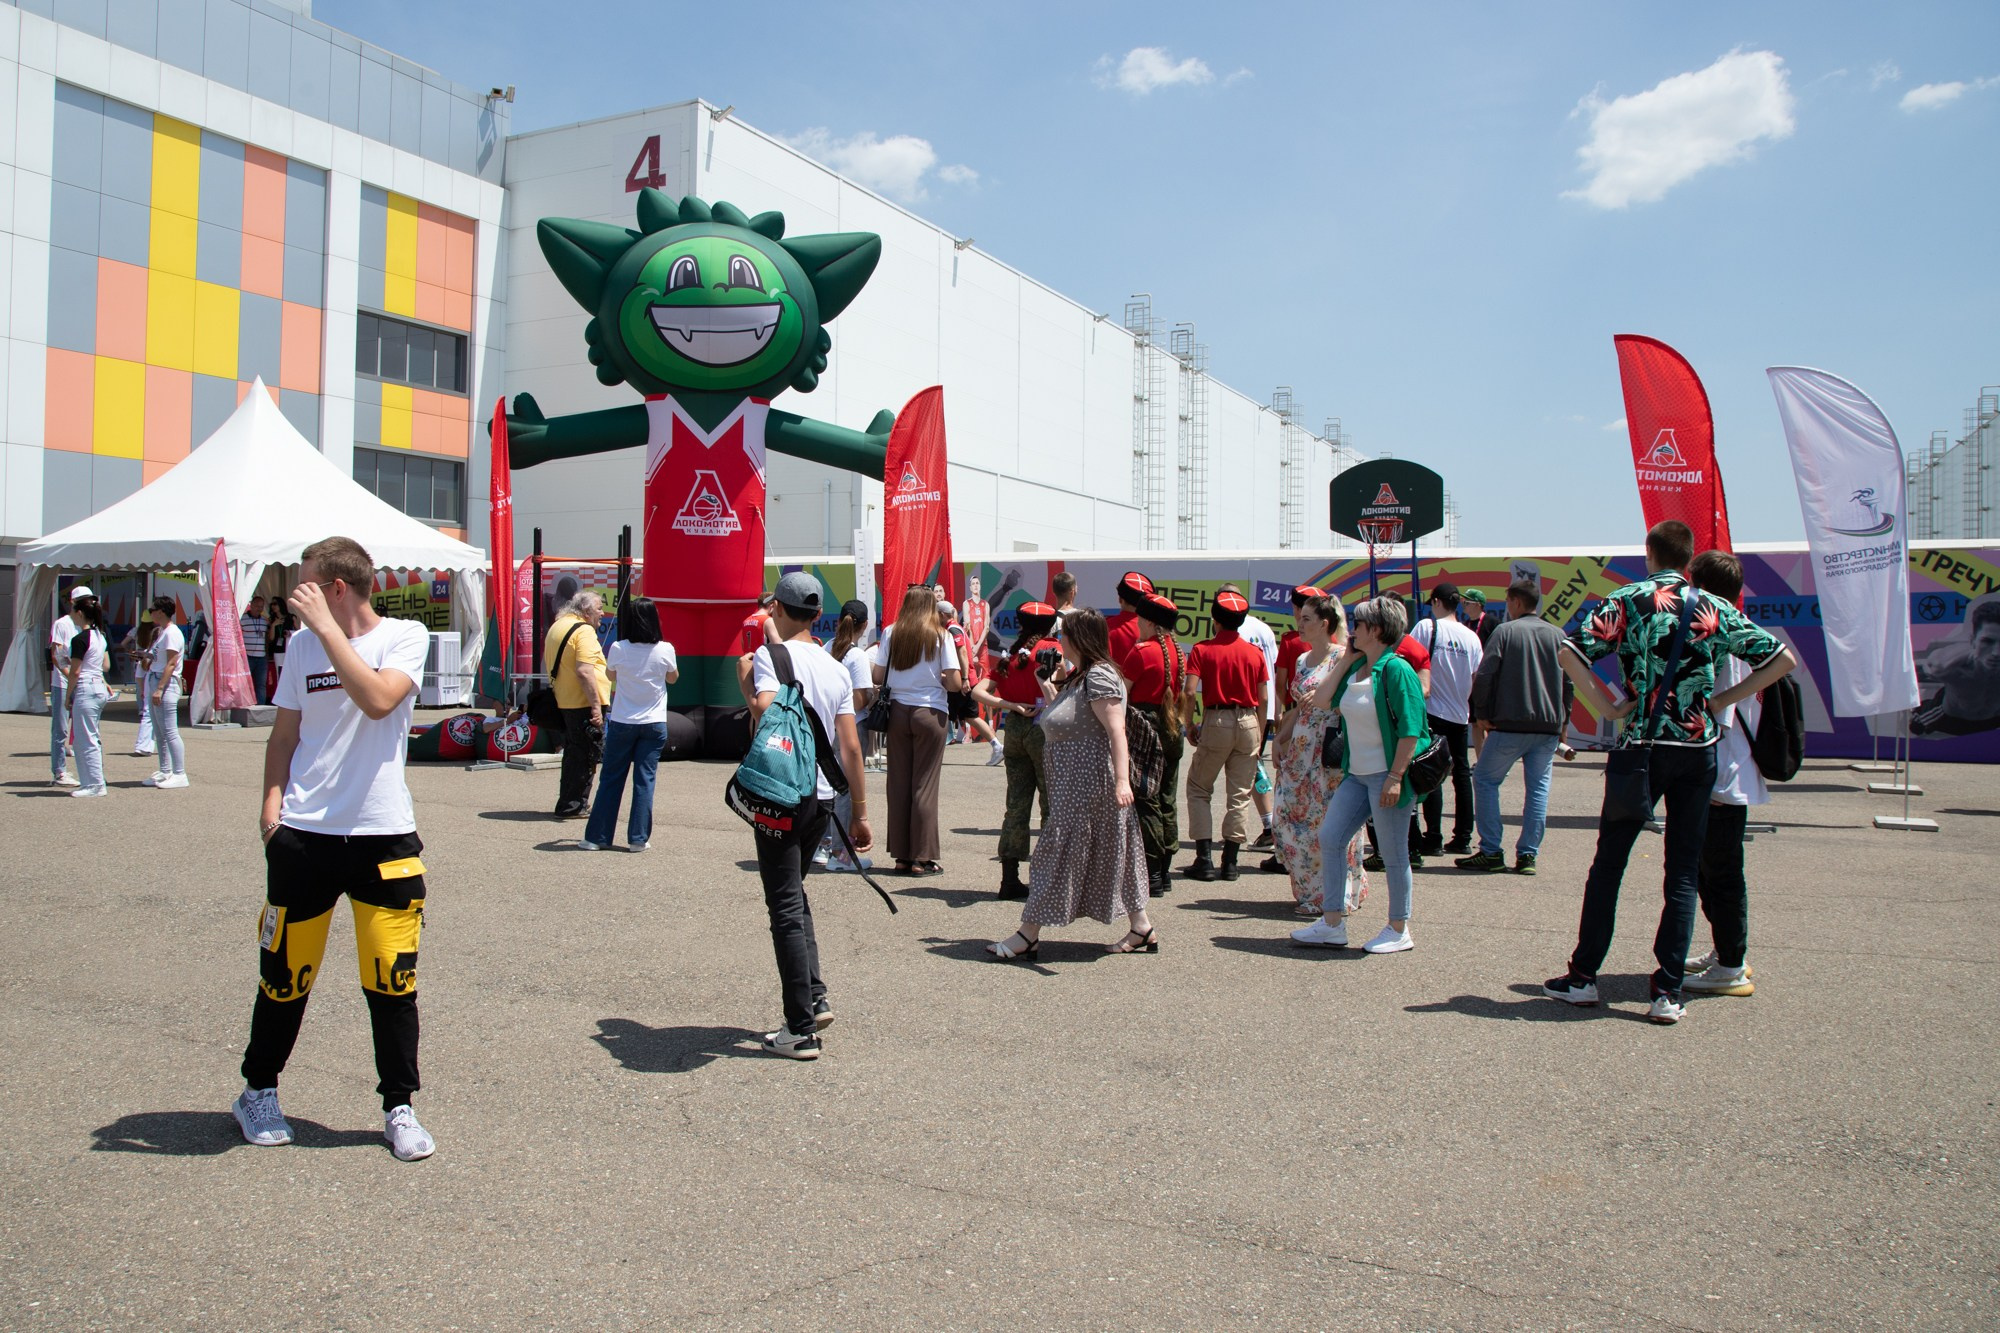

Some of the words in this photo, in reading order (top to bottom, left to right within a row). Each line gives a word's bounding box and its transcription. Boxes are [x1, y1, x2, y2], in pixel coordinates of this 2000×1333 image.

[626, 135, 666, 193] 4
[892, 491, 941, 507] ЛКОМОТИВ
[1361, 506, 1411, 516] ЛОКОМОТИВ
[675, 520, 738, 528] ЛОКОМОТИВ
[1909, 550, 2000, 594] ТРЕЧУ
[436, 585, 447, 595] 24
[1262, 587, 1280, 602] 24
[1540, 569, 1588, 622] ТРЕЧУ
[374, 593, 427, 611] ДЕНЬ
[1746, 603, 1802, 620] РЕЧУ
[738, 791, 782, 818] TOMMY
